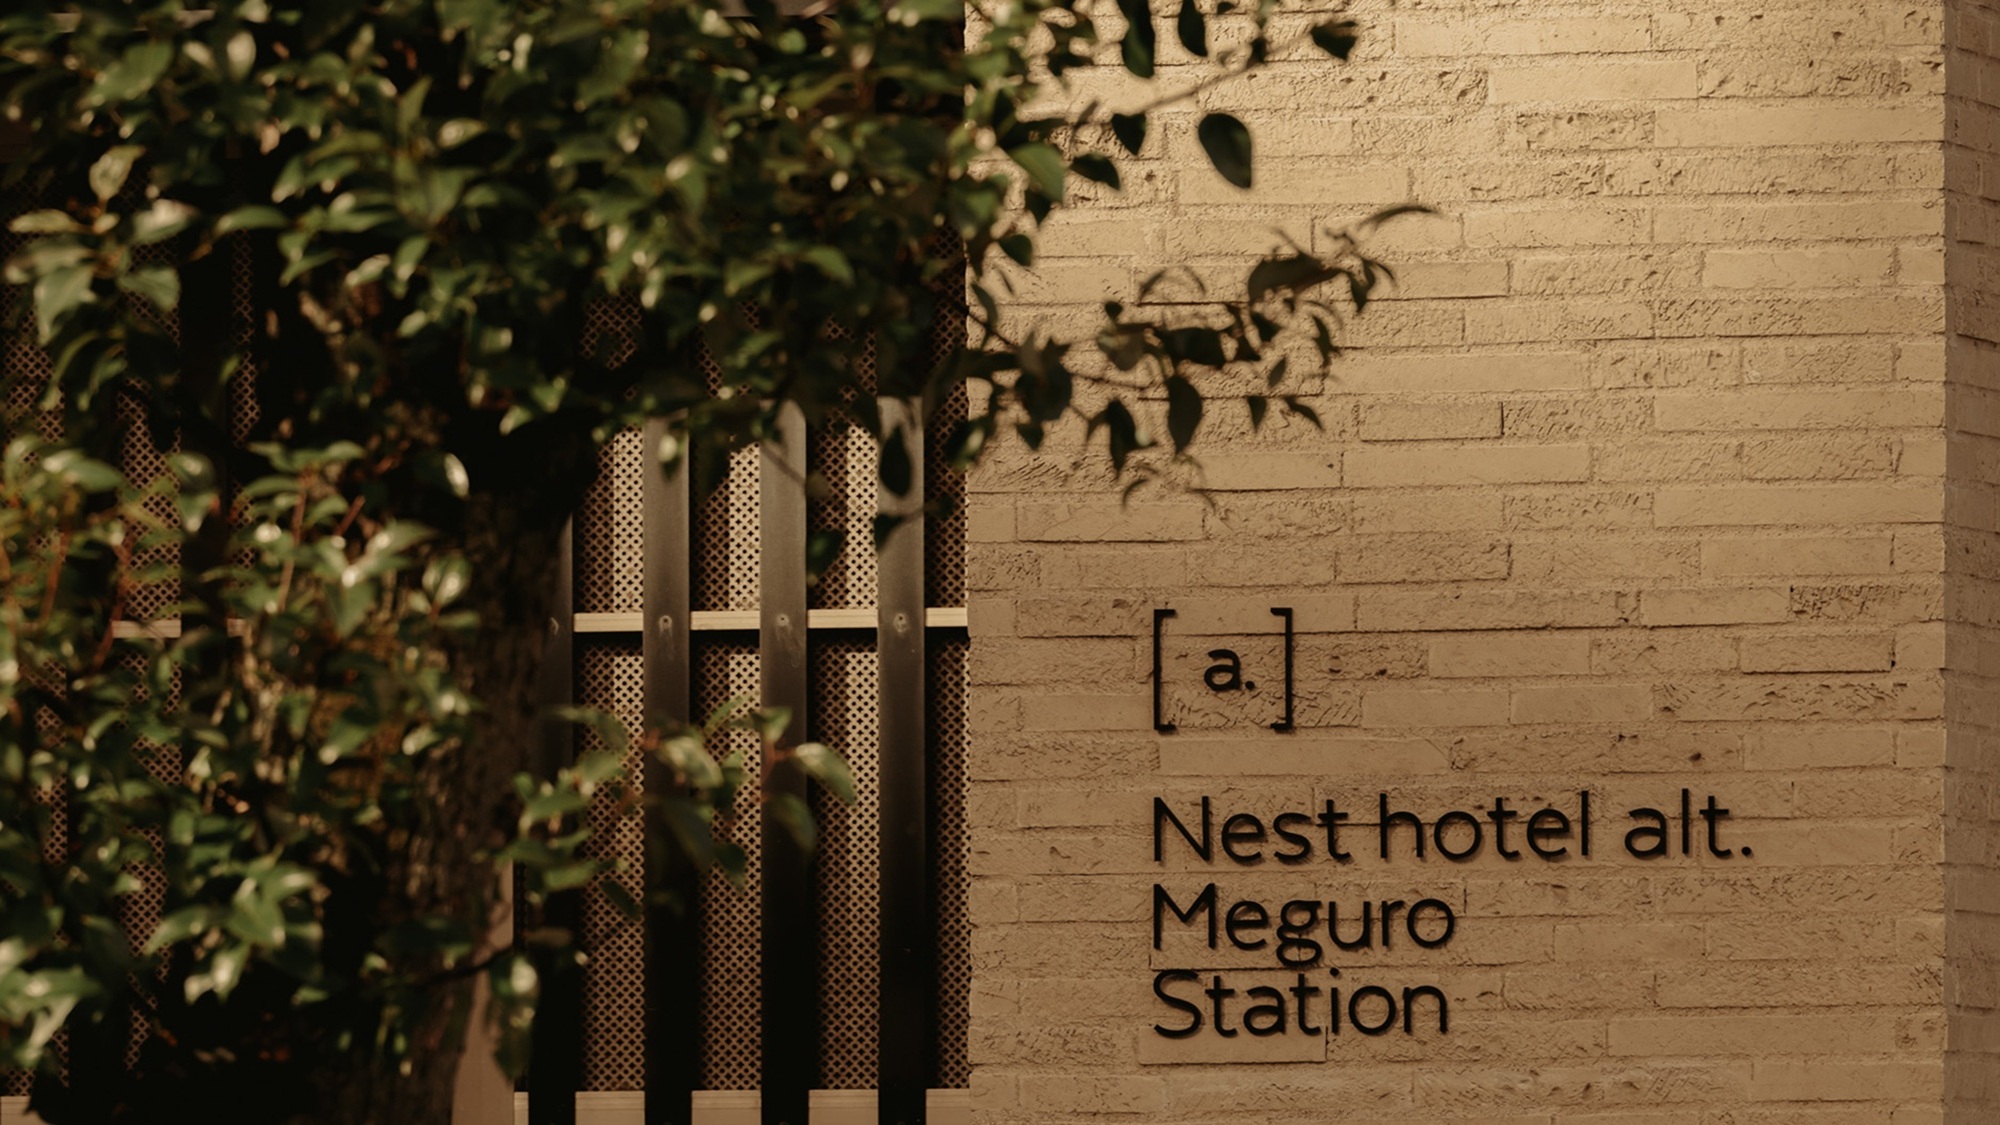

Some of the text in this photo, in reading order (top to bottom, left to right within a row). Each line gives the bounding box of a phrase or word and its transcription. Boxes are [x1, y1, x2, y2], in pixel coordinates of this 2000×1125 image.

[1153, 788, 1753, 864] Nest hotel alt.
[1153, 883, 1456, 966] Meguro
[1152, 967, 1448, 1038] Station
